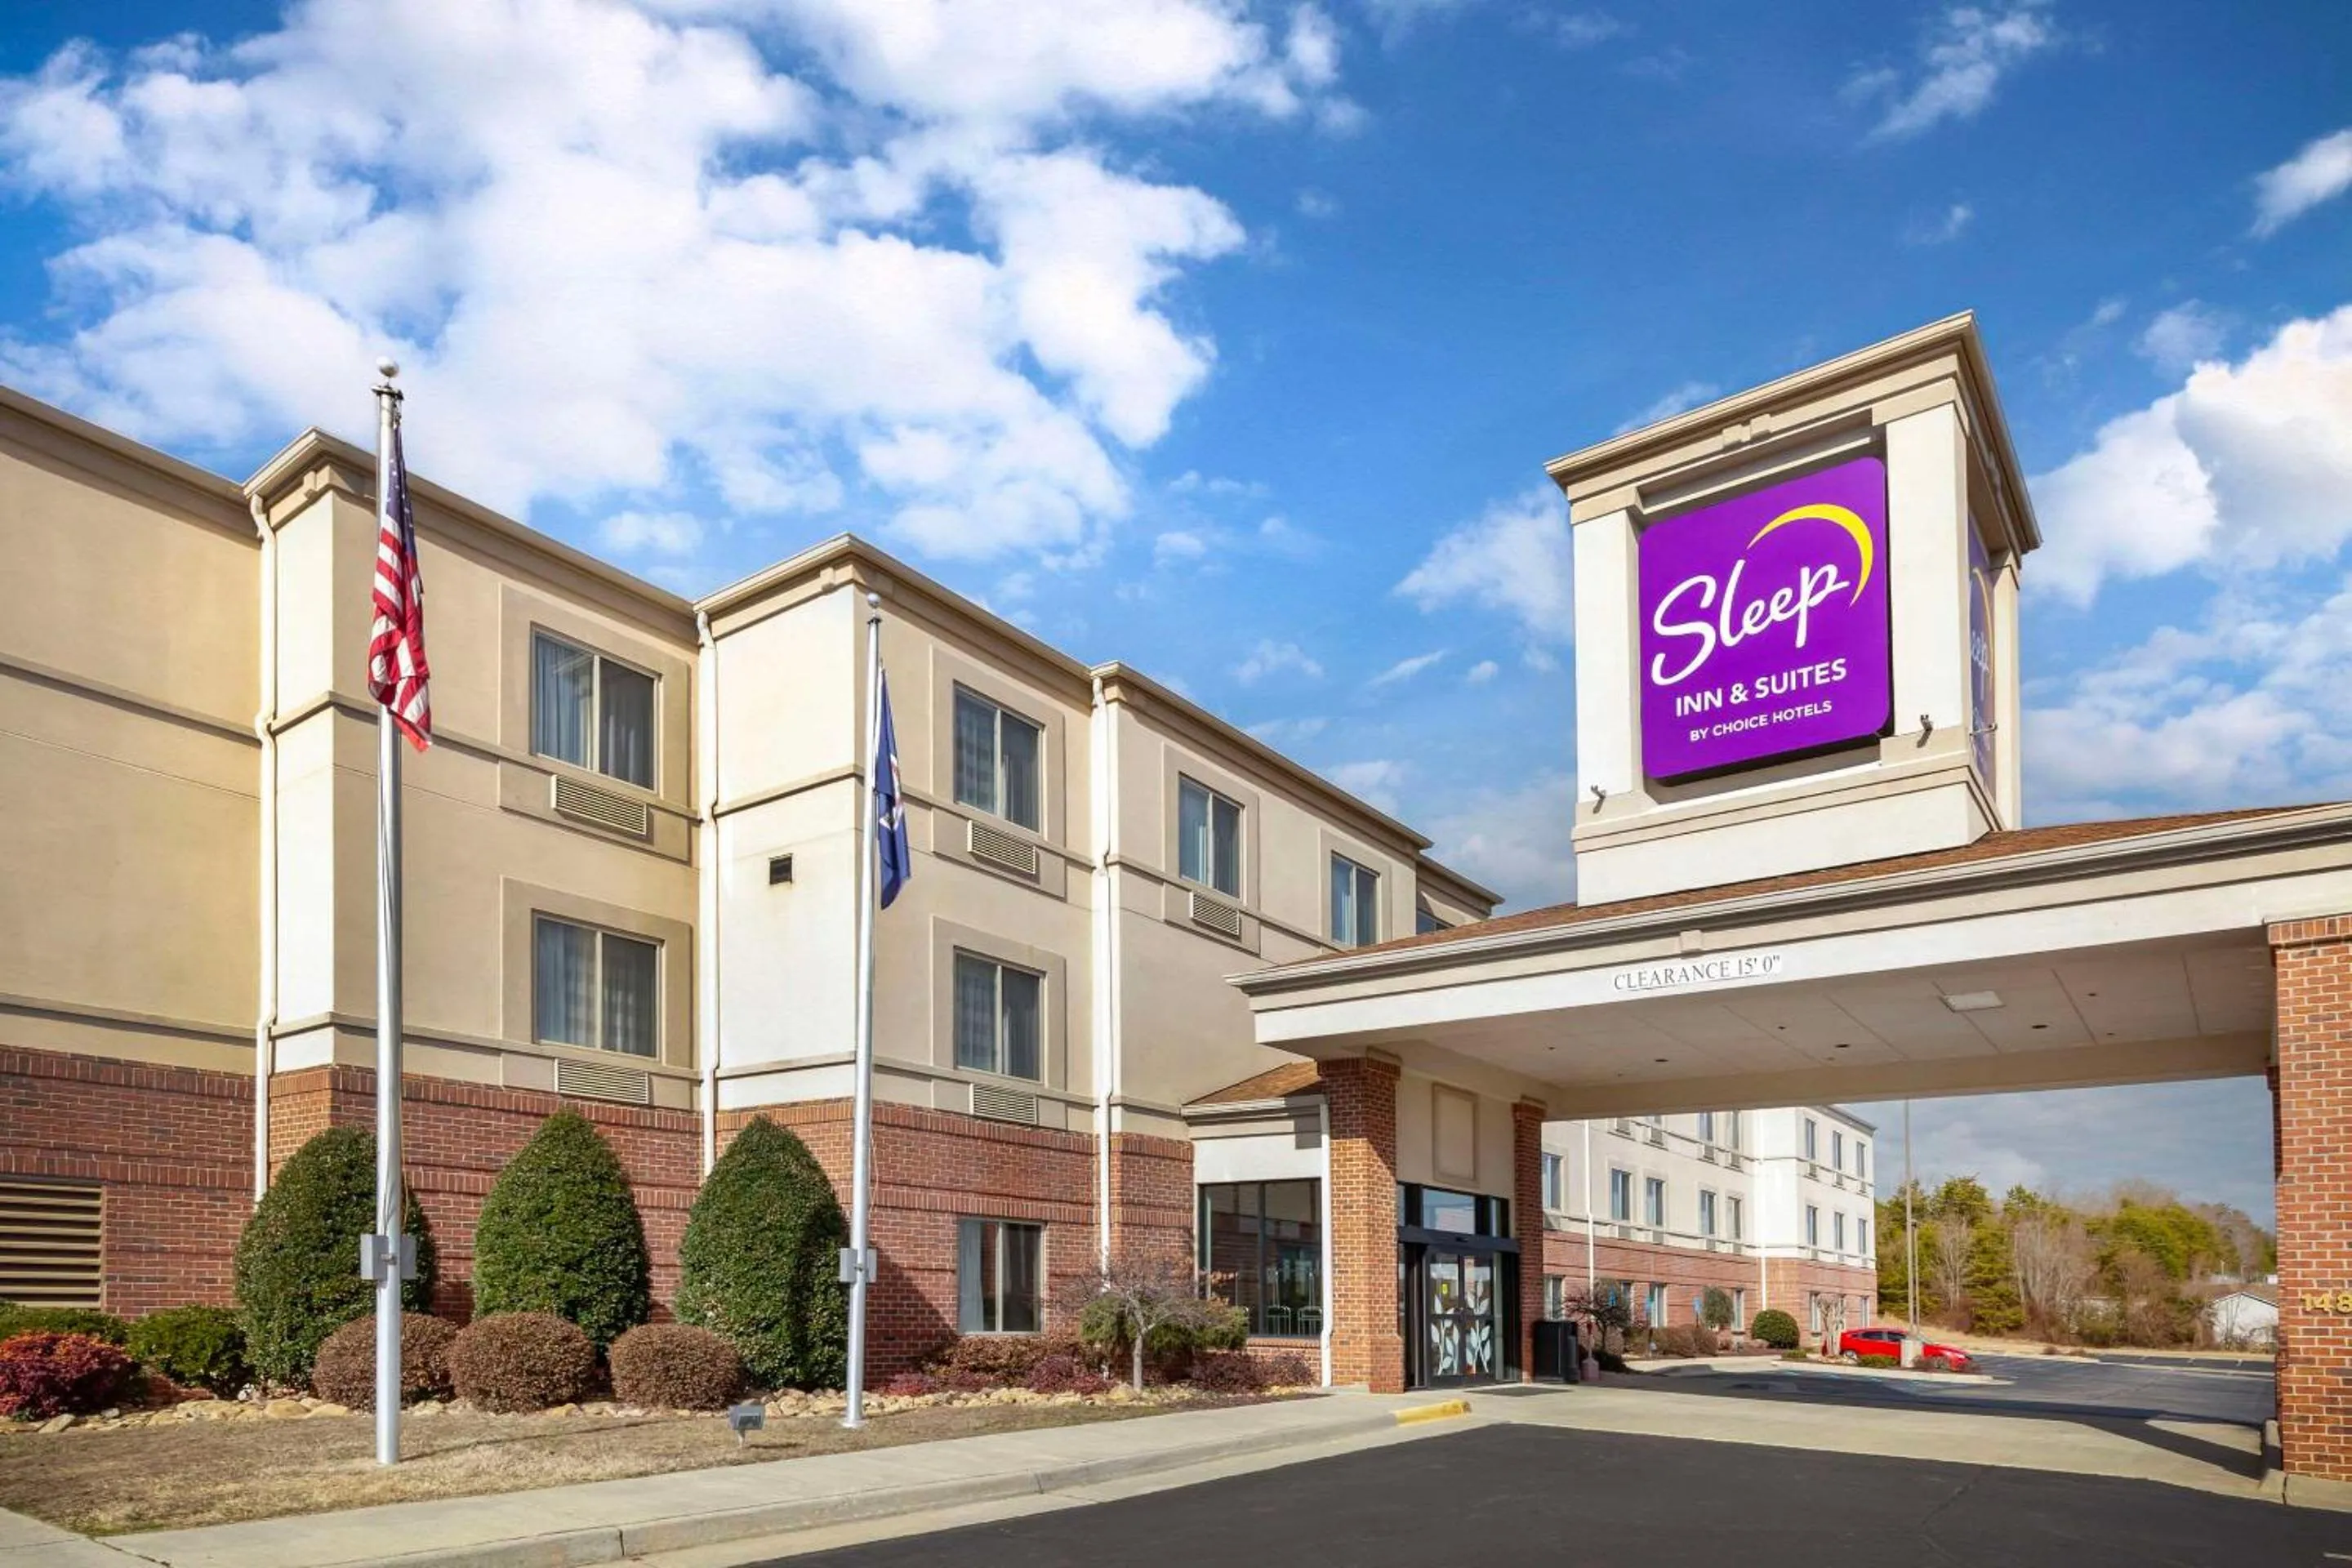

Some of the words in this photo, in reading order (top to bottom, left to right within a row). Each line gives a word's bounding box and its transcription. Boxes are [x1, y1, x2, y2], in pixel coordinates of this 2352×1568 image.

[1651, 559, 1850, 686] Sleep
[1676, 688, 1722, 717] INN
[1730, 683, 1748, 705] &
[1755, 657, 1846, 699] SUITES
[1690, 727, 1709, 742] BY
[1713, 714, 1768, 737] CHOICE
[1772, 700, 1833, 724] HOTELS
[1614, 960, 1731, 991] CLEARANCE
